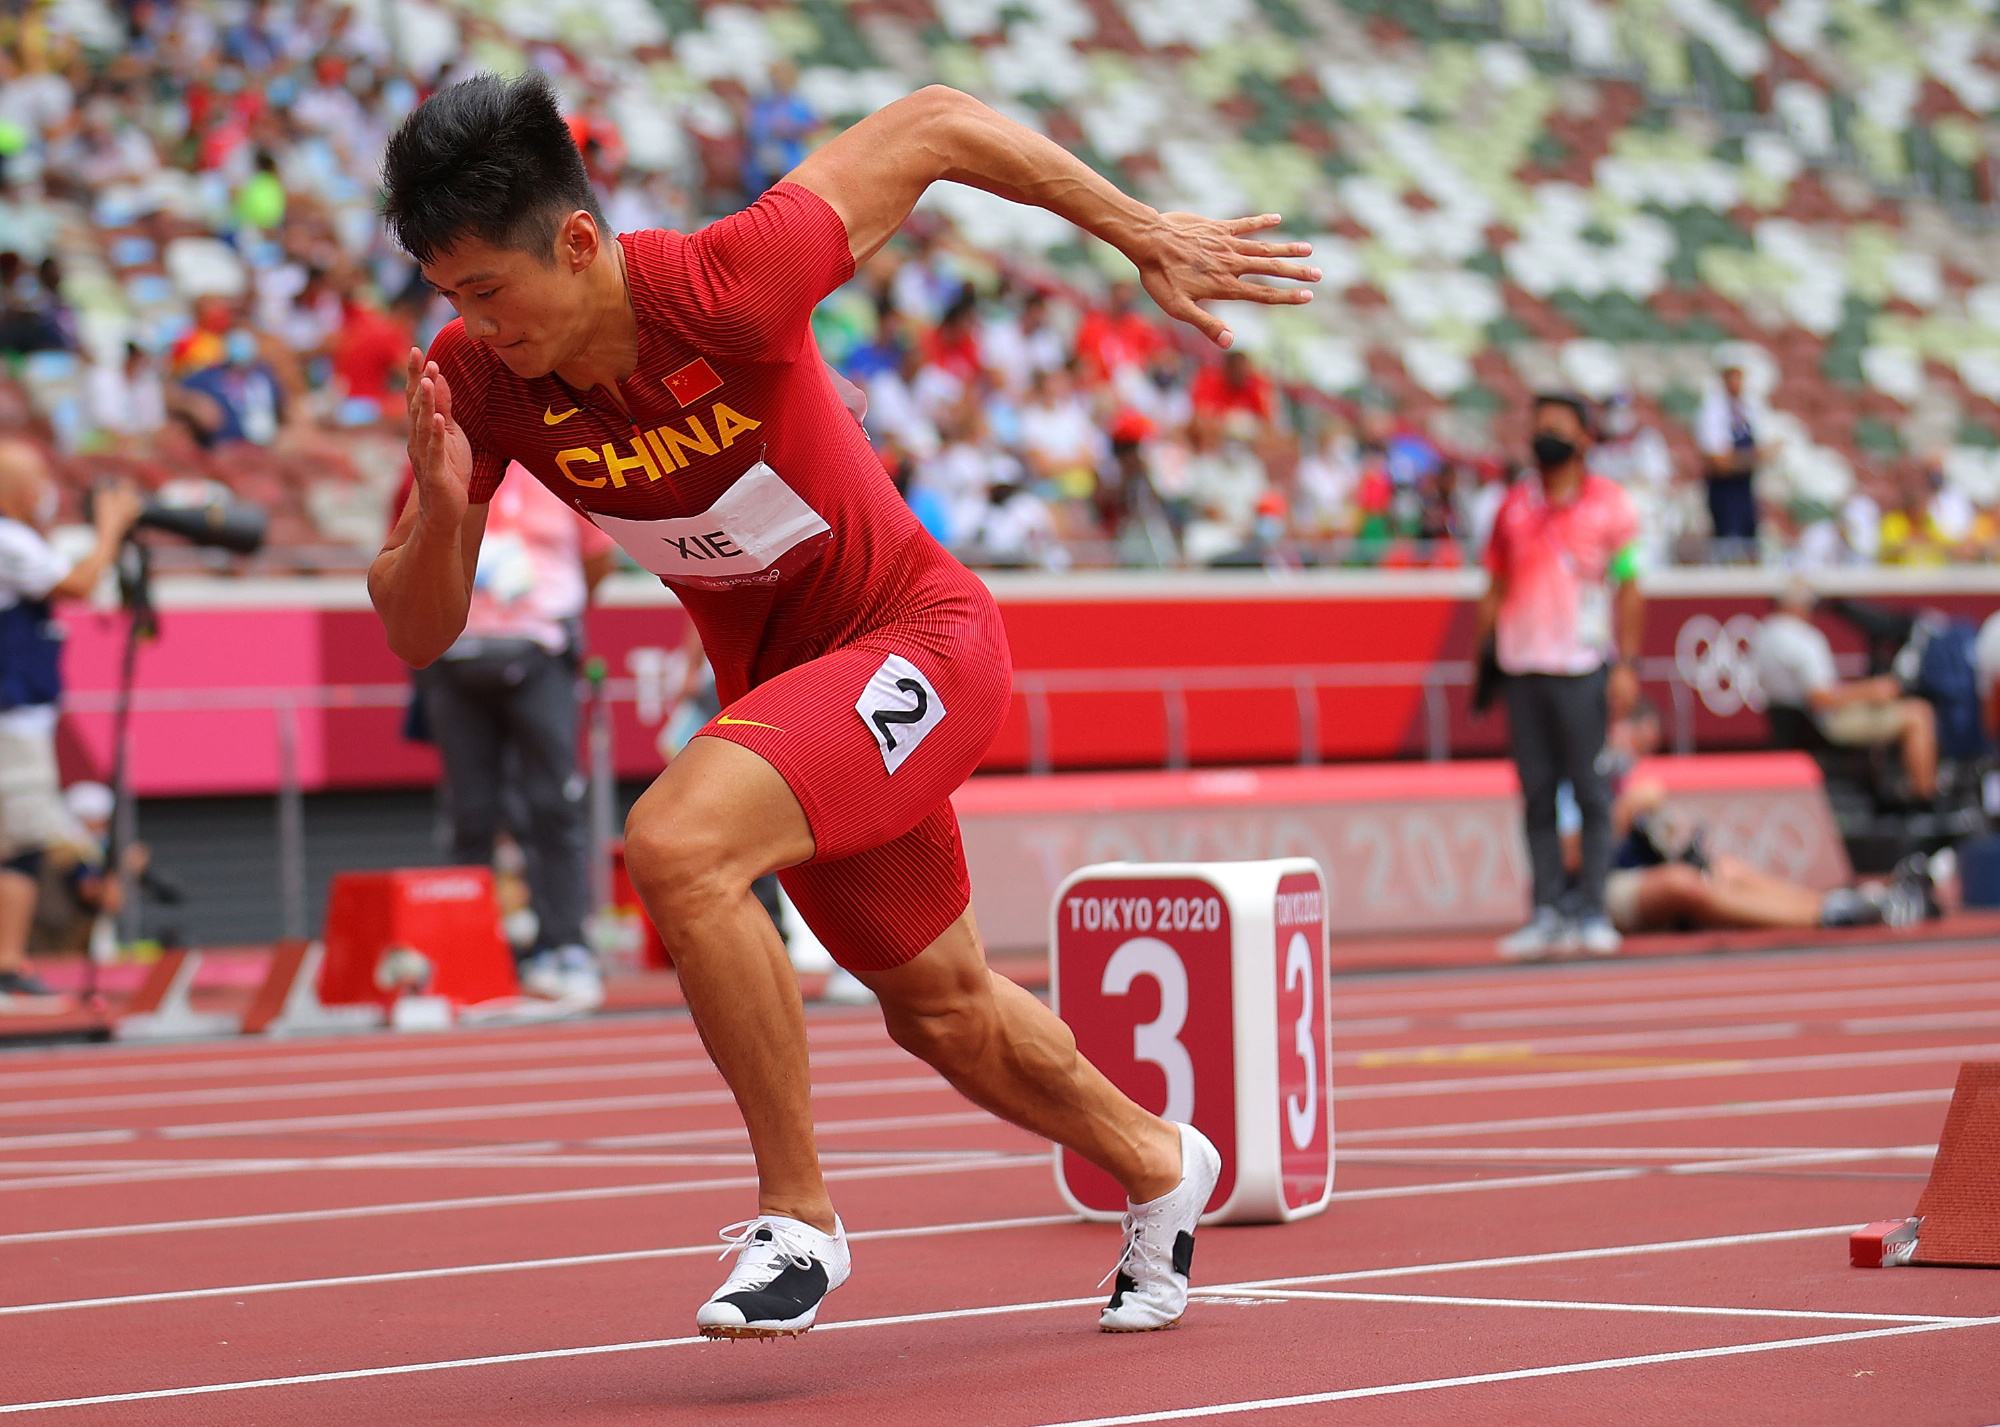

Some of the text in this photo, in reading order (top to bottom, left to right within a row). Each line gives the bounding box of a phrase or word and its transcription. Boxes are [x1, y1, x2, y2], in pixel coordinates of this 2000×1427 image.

[555, 402, 762, 489] CHINA
[662, 530, 743, 560] XIE
[871, 677, 928, 753] 2
[1067, 897, 1221, 932] TOKYO 2020
[1101, 936, 1196, 1126] 3
[1284, 931, 1318, 1150] 3
